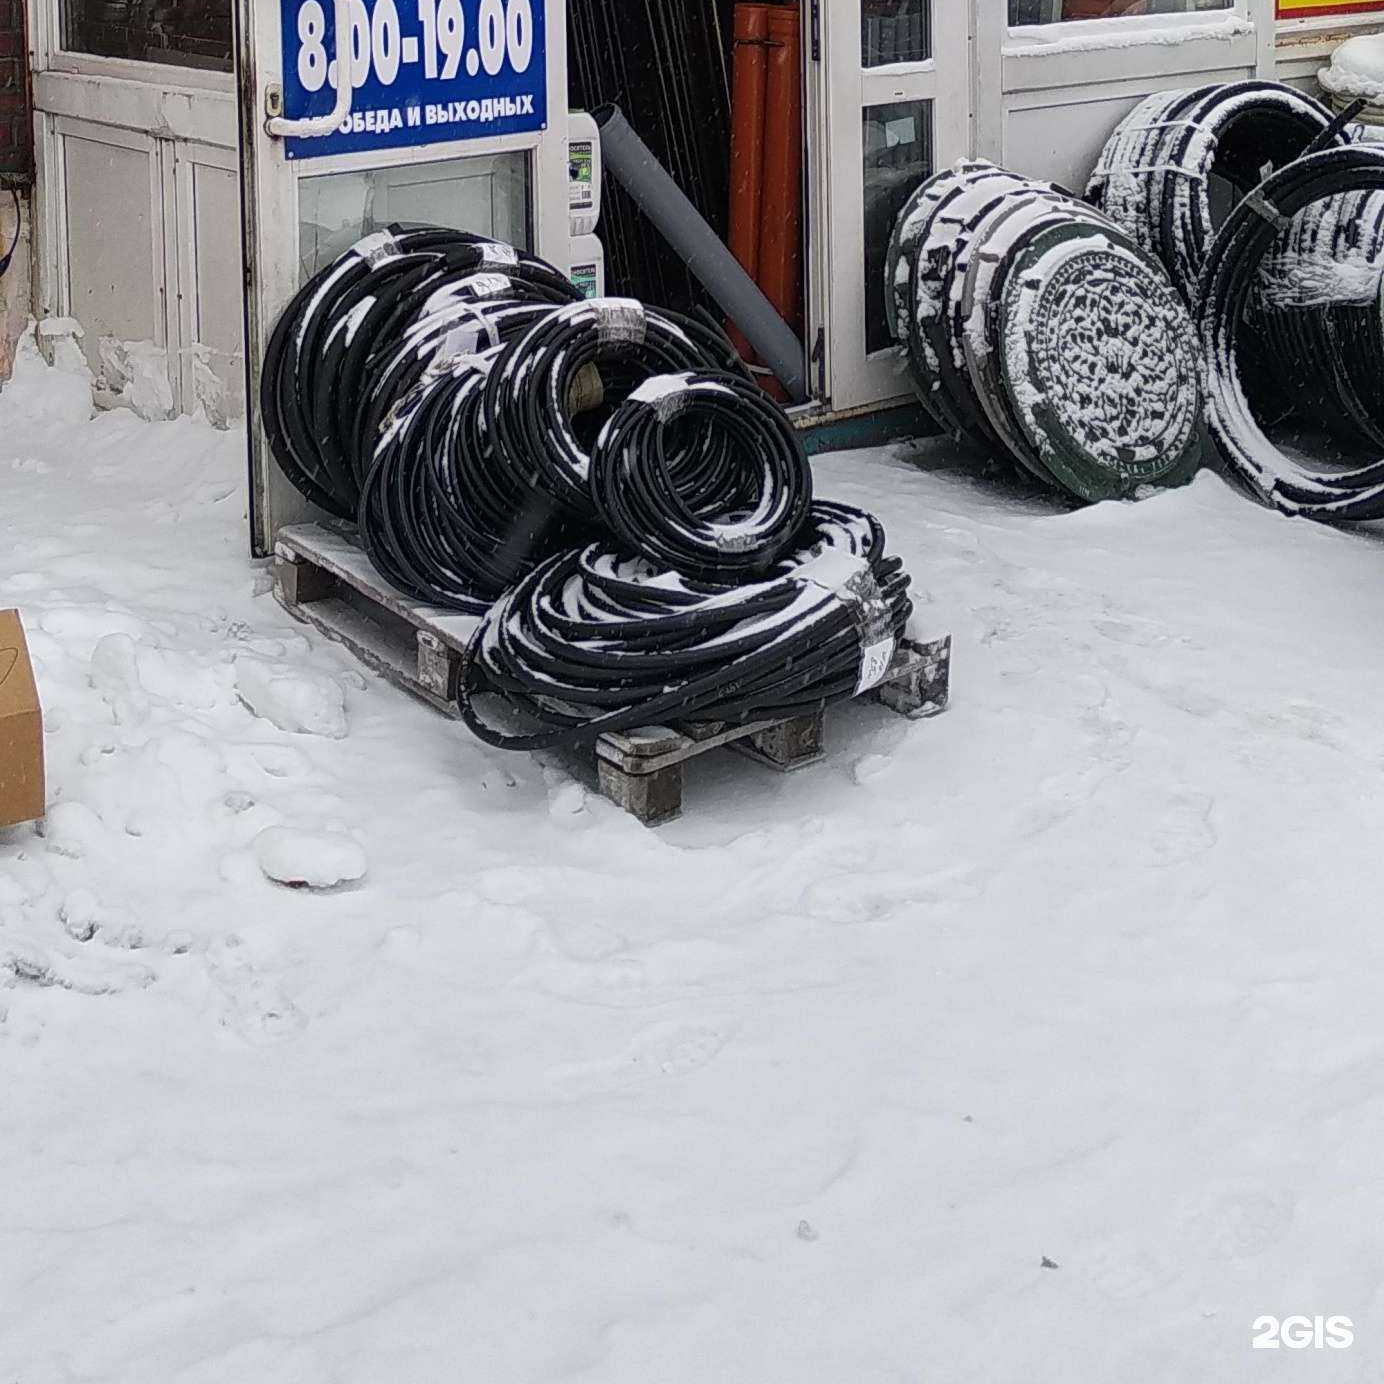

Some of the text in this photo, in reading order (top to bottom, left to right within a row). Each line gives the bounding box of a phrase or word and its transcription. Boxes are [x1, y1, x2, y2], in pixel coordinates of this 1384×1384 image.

[338, 108, 402, 134] ОБЕДА
[407, 109, 421, 127] И
[425, 94, 534, 125] ВЫХОДНЫХ
